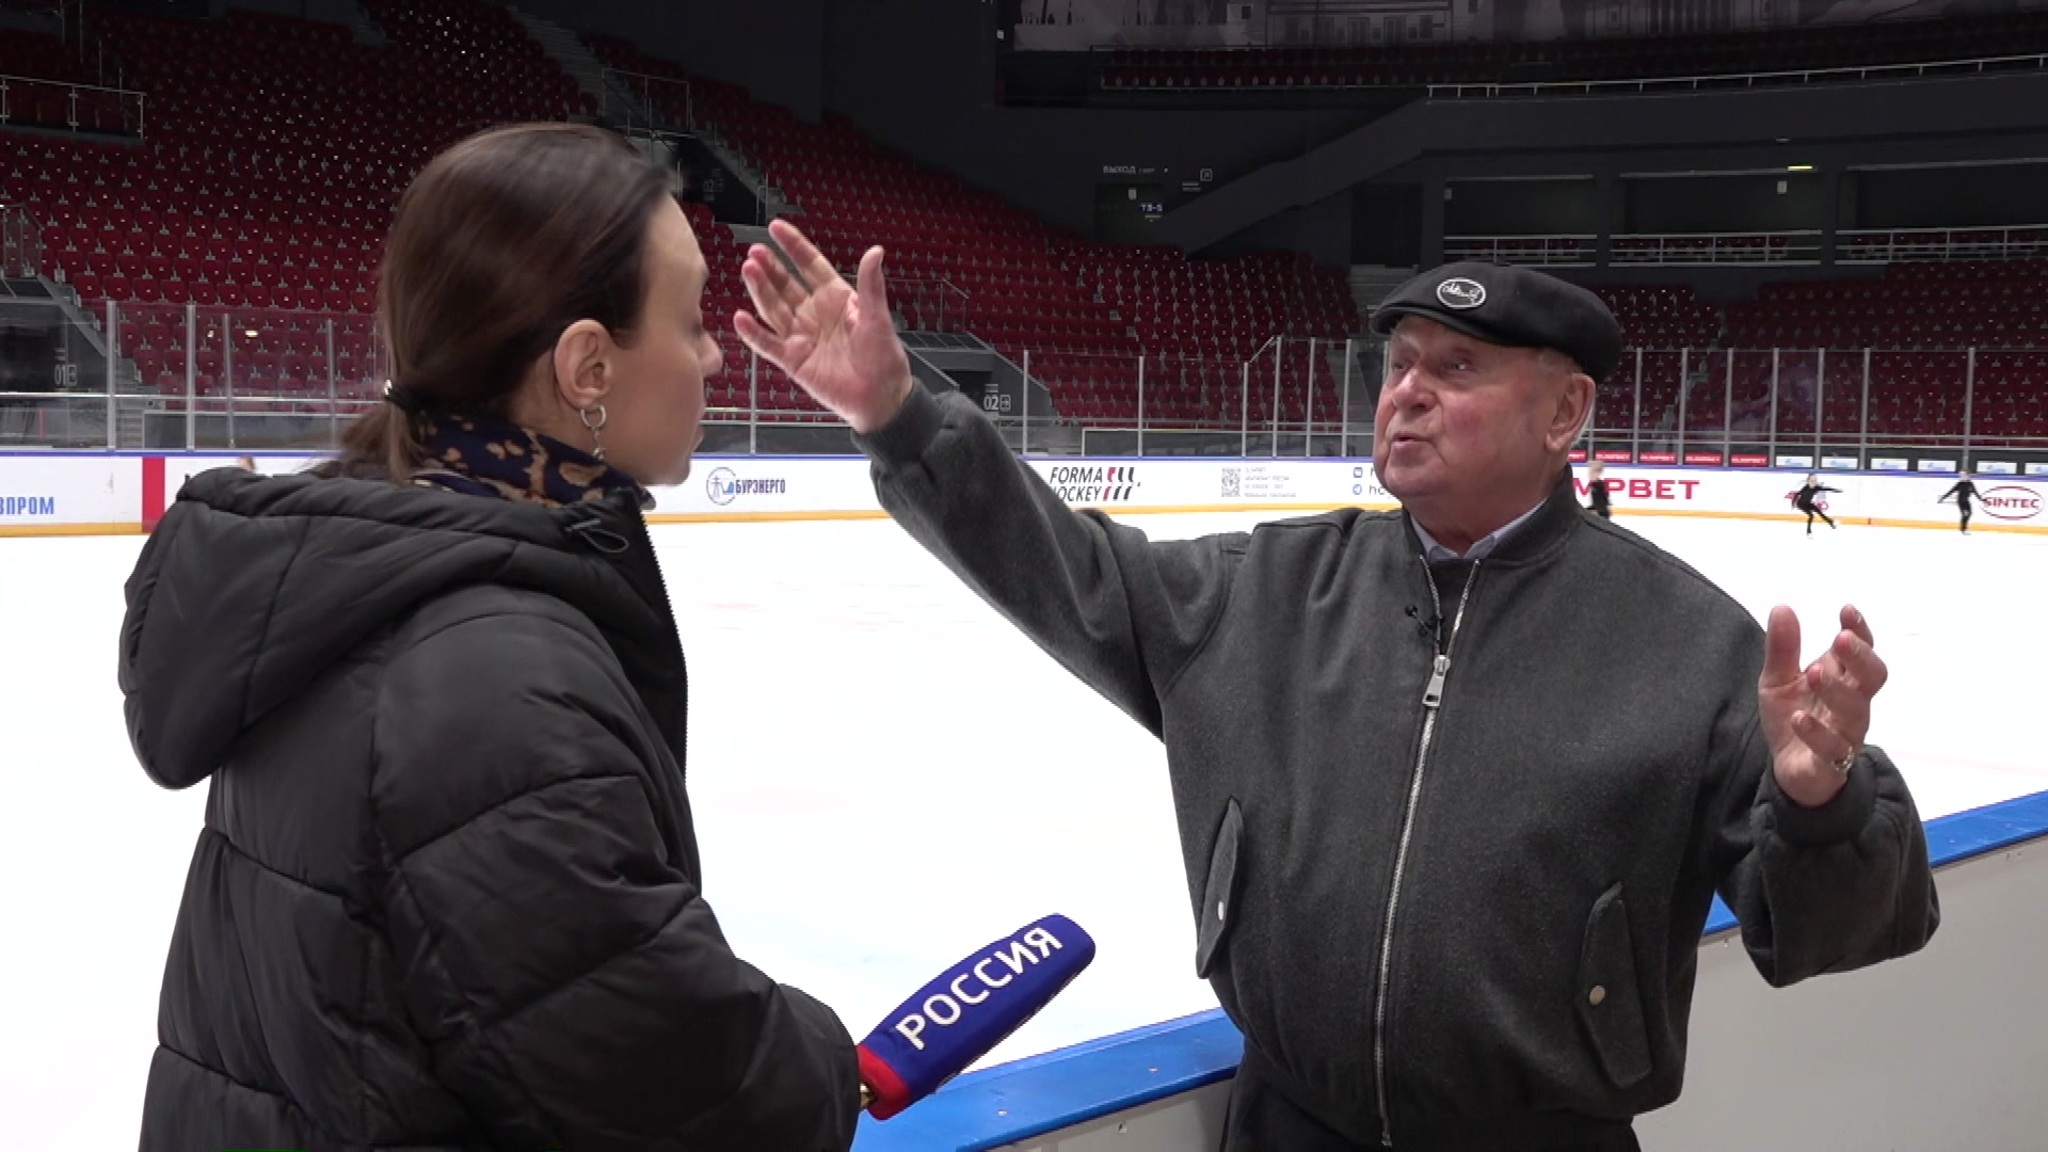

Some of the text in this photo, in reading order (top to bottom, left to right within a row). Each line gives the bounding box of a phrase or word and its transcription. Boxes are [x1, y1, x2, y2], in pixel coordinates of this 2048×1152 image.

[983, 394, 999, 411] 02
[1050, 466, 1103, 484] FORMA
[735, 479, 786, 494] БУРЭНЕРГО
[1984, 497, 2040, 509] SINTEC
[894, 926, 1064, 1051] РОССИЯ
